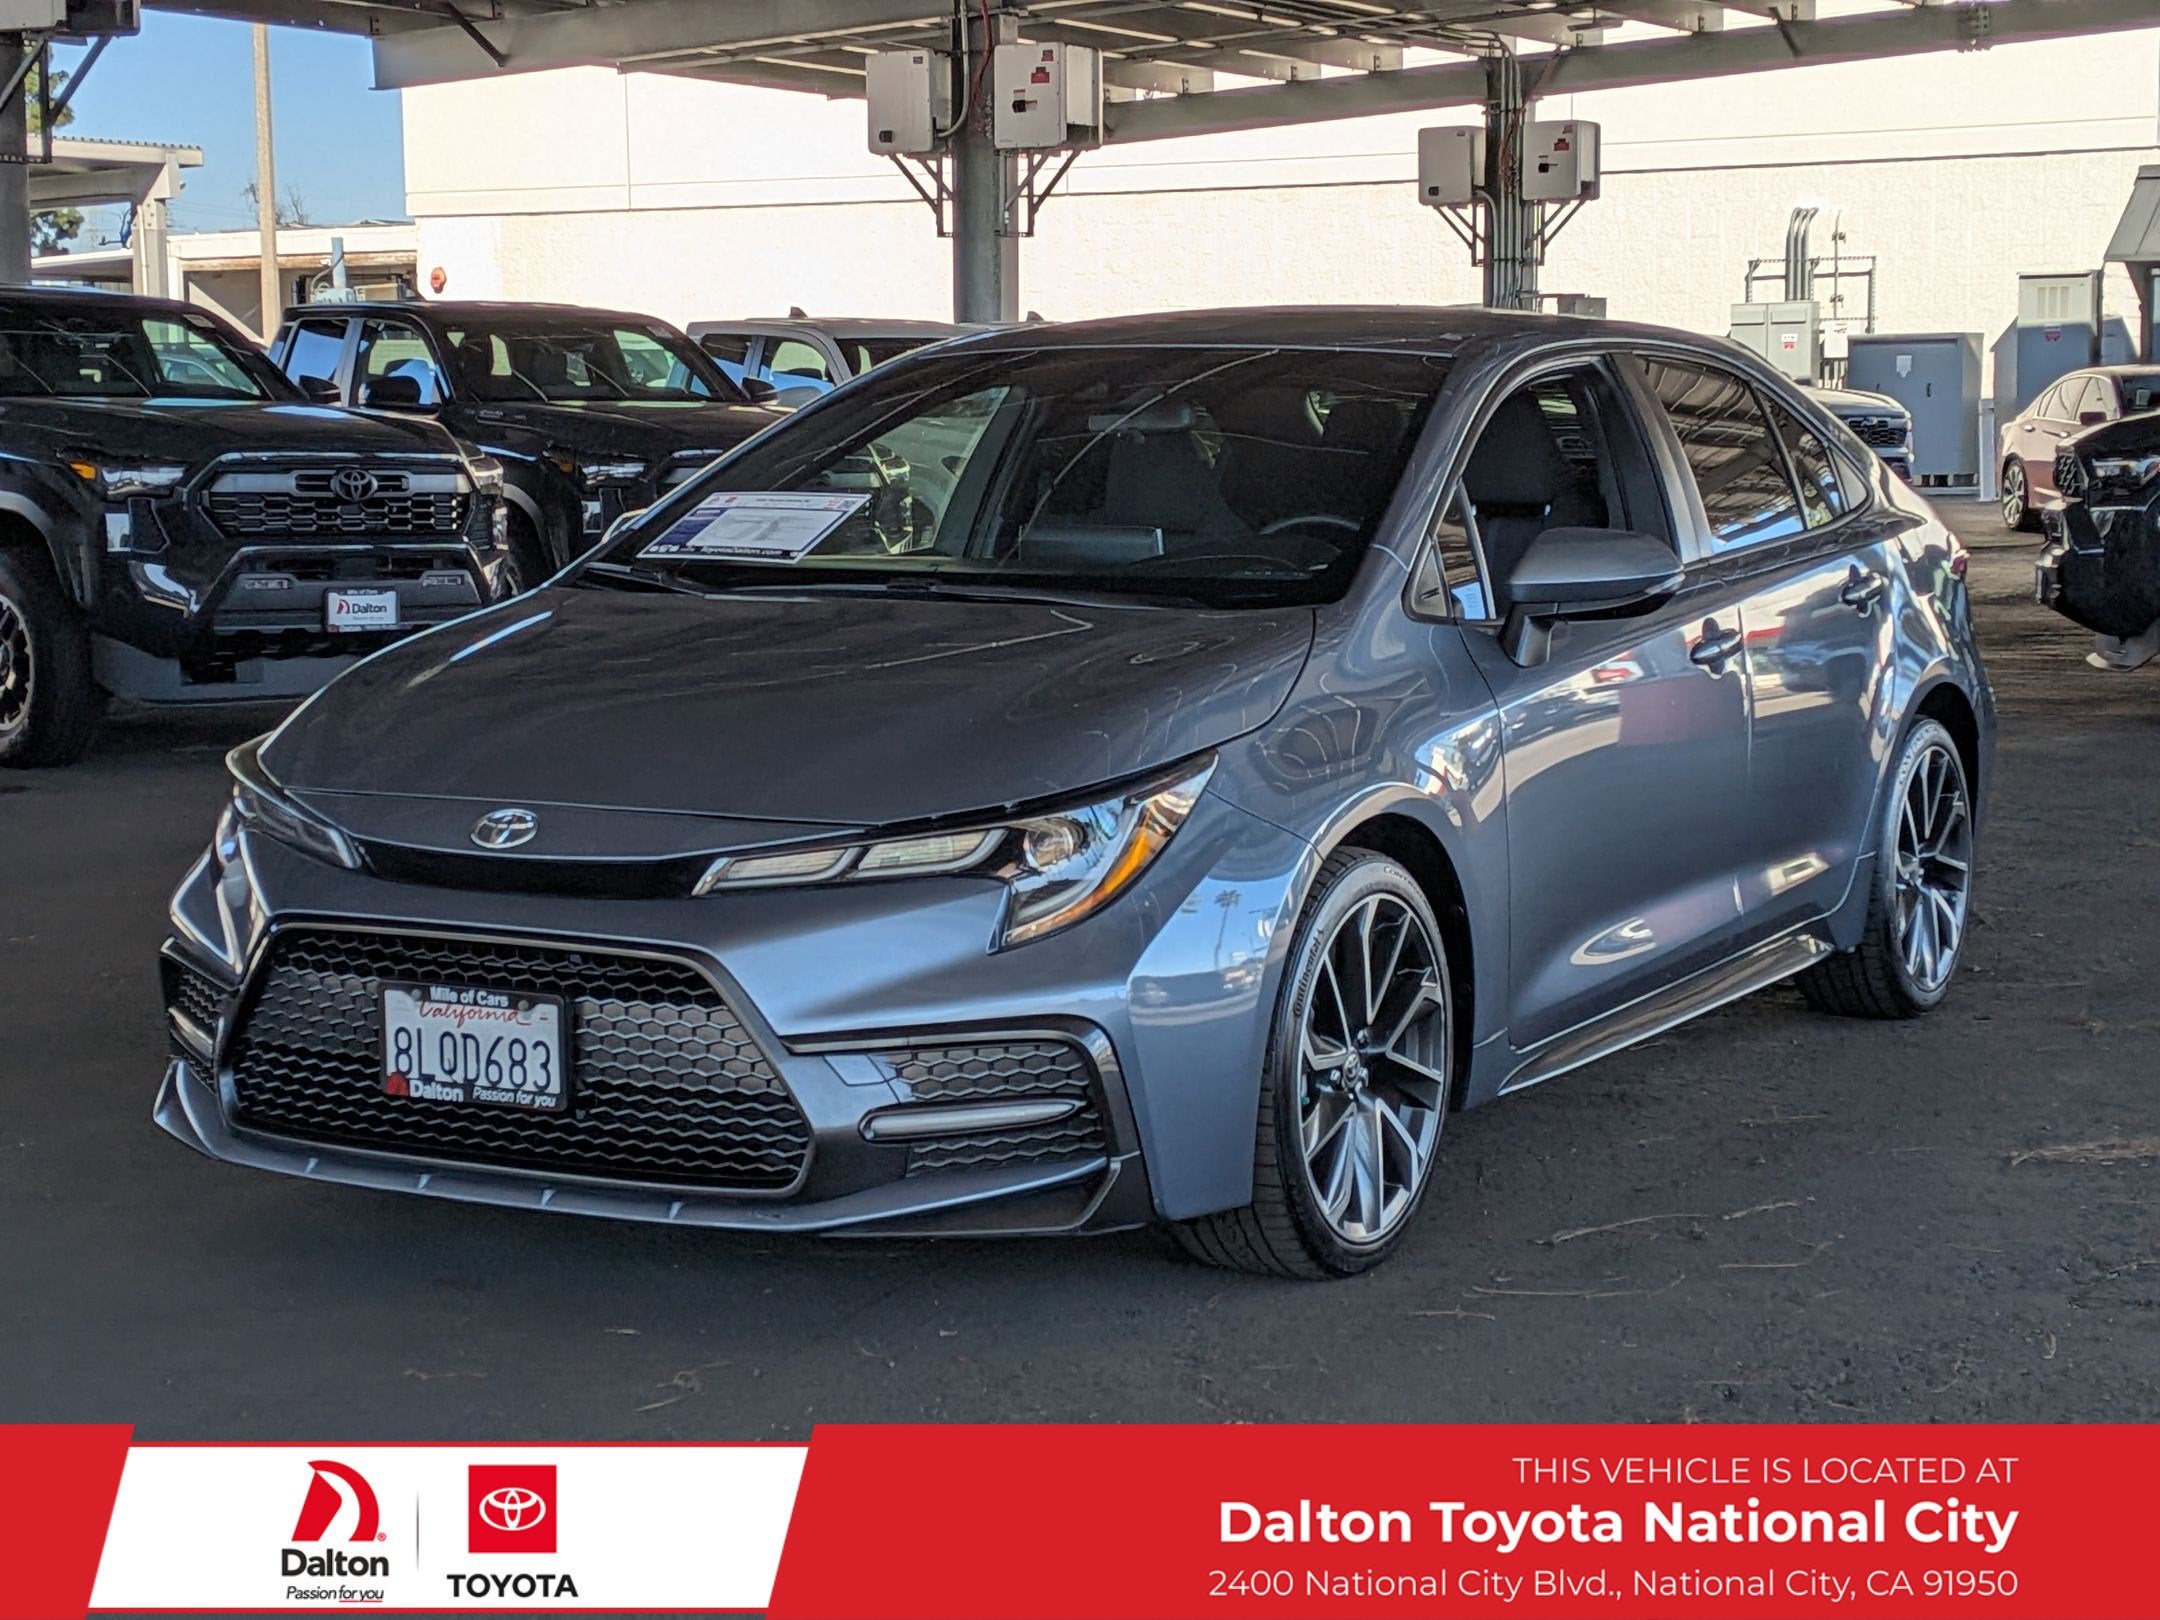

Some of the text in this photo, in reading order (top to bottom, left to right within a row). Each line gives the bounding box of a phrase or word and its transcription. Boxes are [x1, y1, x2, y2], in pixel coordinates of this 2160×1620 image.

[352, 603, 387, 613] Dalton
[430, 987, 509, 1007] Mile of Cars
[420, 1002, 532, 1029] California
[394, 1026, 551, 1092] 8LQD683
[409, 1080, 464, 1102] Dalton
[473, 1086, 556, 1108] Passion for you
